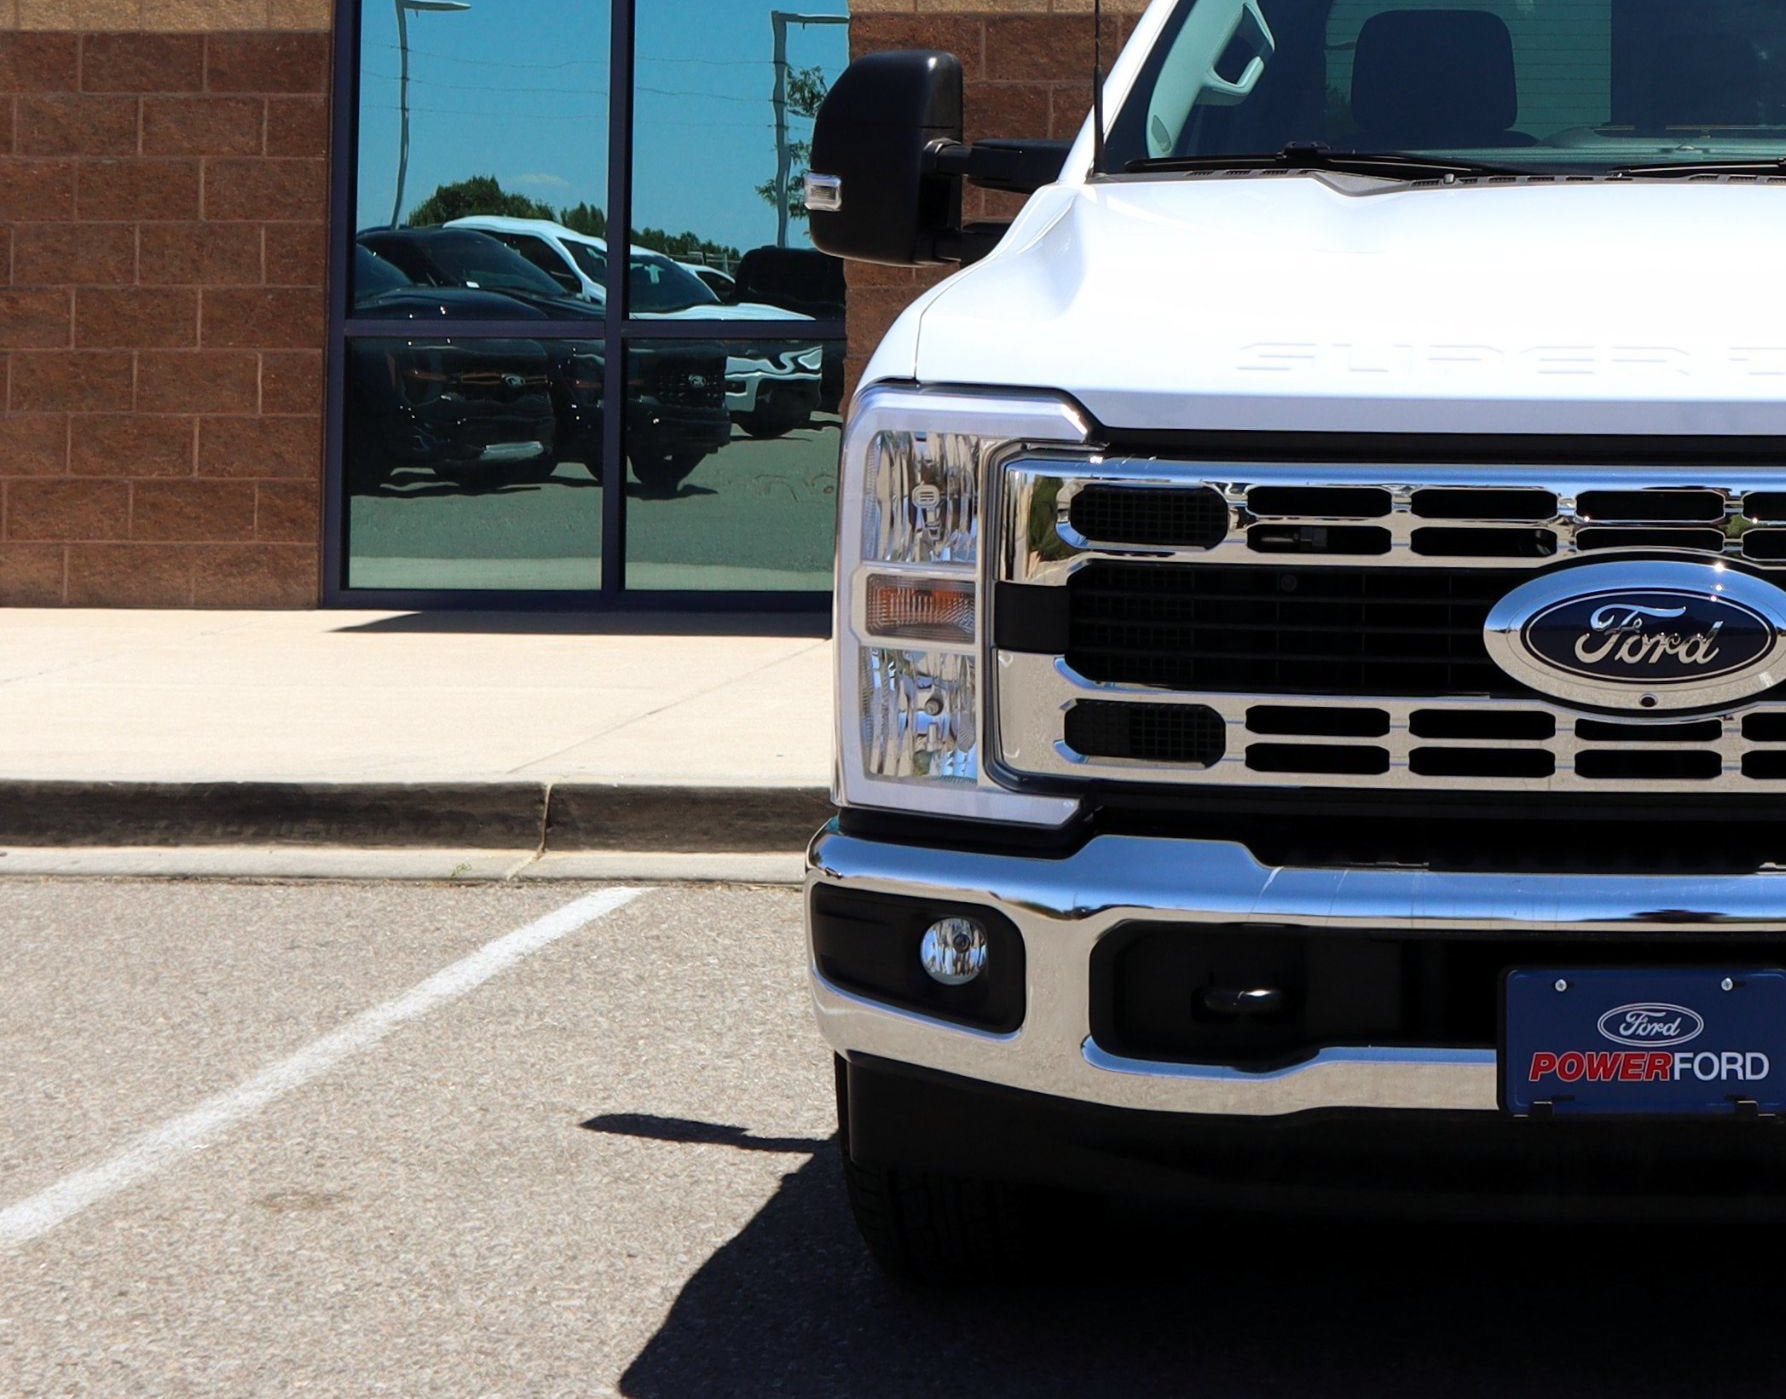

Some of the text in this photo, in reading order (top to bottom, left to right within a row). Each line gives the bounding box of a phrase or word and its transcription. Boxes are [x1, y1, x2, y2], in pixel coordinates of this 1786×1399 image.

[1575, 603, 1725, 665] Ford
[1618, 1010, 1682, 1037] Ford
[1528, 1051, 1770, 1083] POWERFORD
